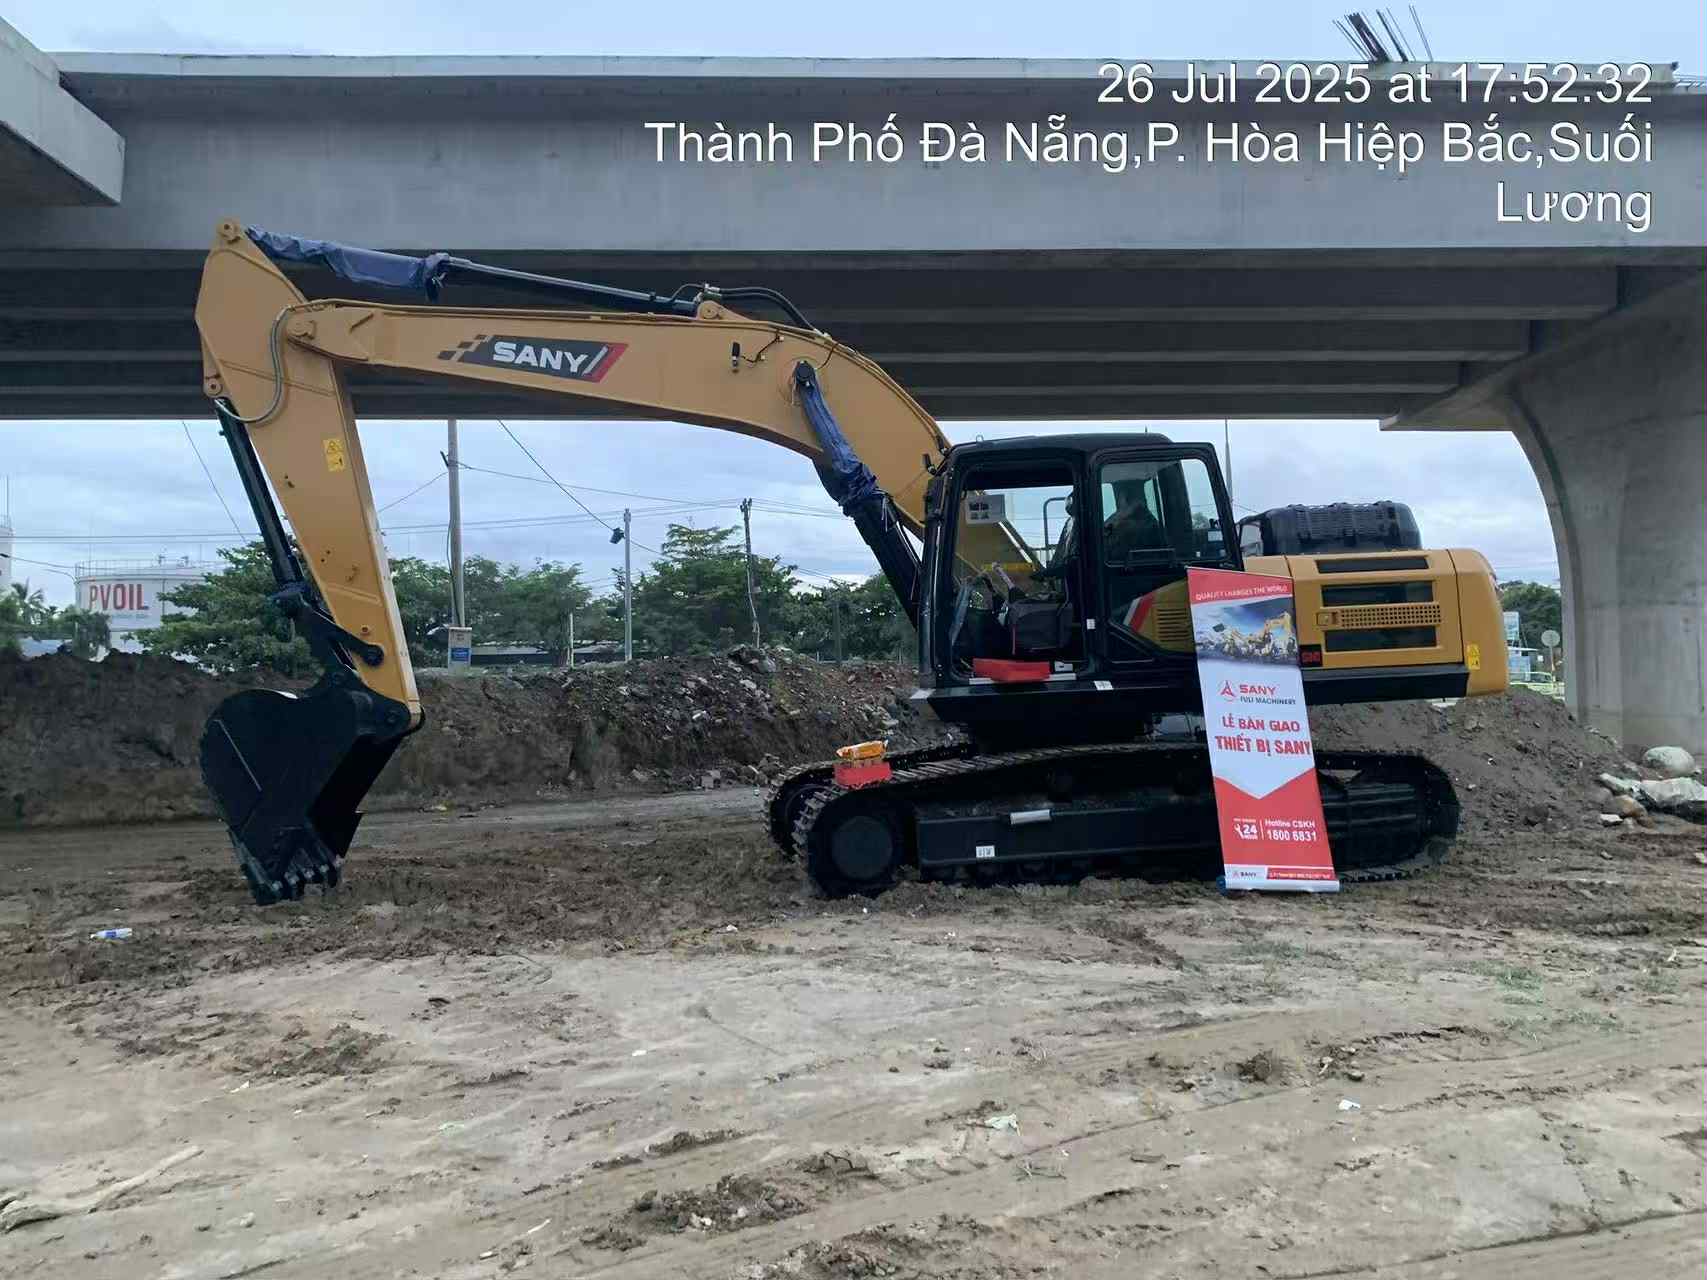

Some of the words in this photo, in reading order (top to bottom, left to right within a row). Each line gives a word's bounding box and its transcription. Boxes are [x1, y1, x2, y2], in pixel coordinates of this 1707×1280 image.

[492, 341, 588, 373] SANY
[89, 583, 149, 611] PVOIL
[1239, 684, 1276, 695] SANY
[1255, 697, 1296, 705] MACHINERY
[1239, 715, 1265, 730] BÀN
[1269, 719, 1300, 732] GIAO
[1214, 733, 1251, 753] THIẾT
[1256, 738, 1271, 756] BỊ
[1274, 739, 1311, 755] SANY
[1264, 818, 1291, 828] Hotline
